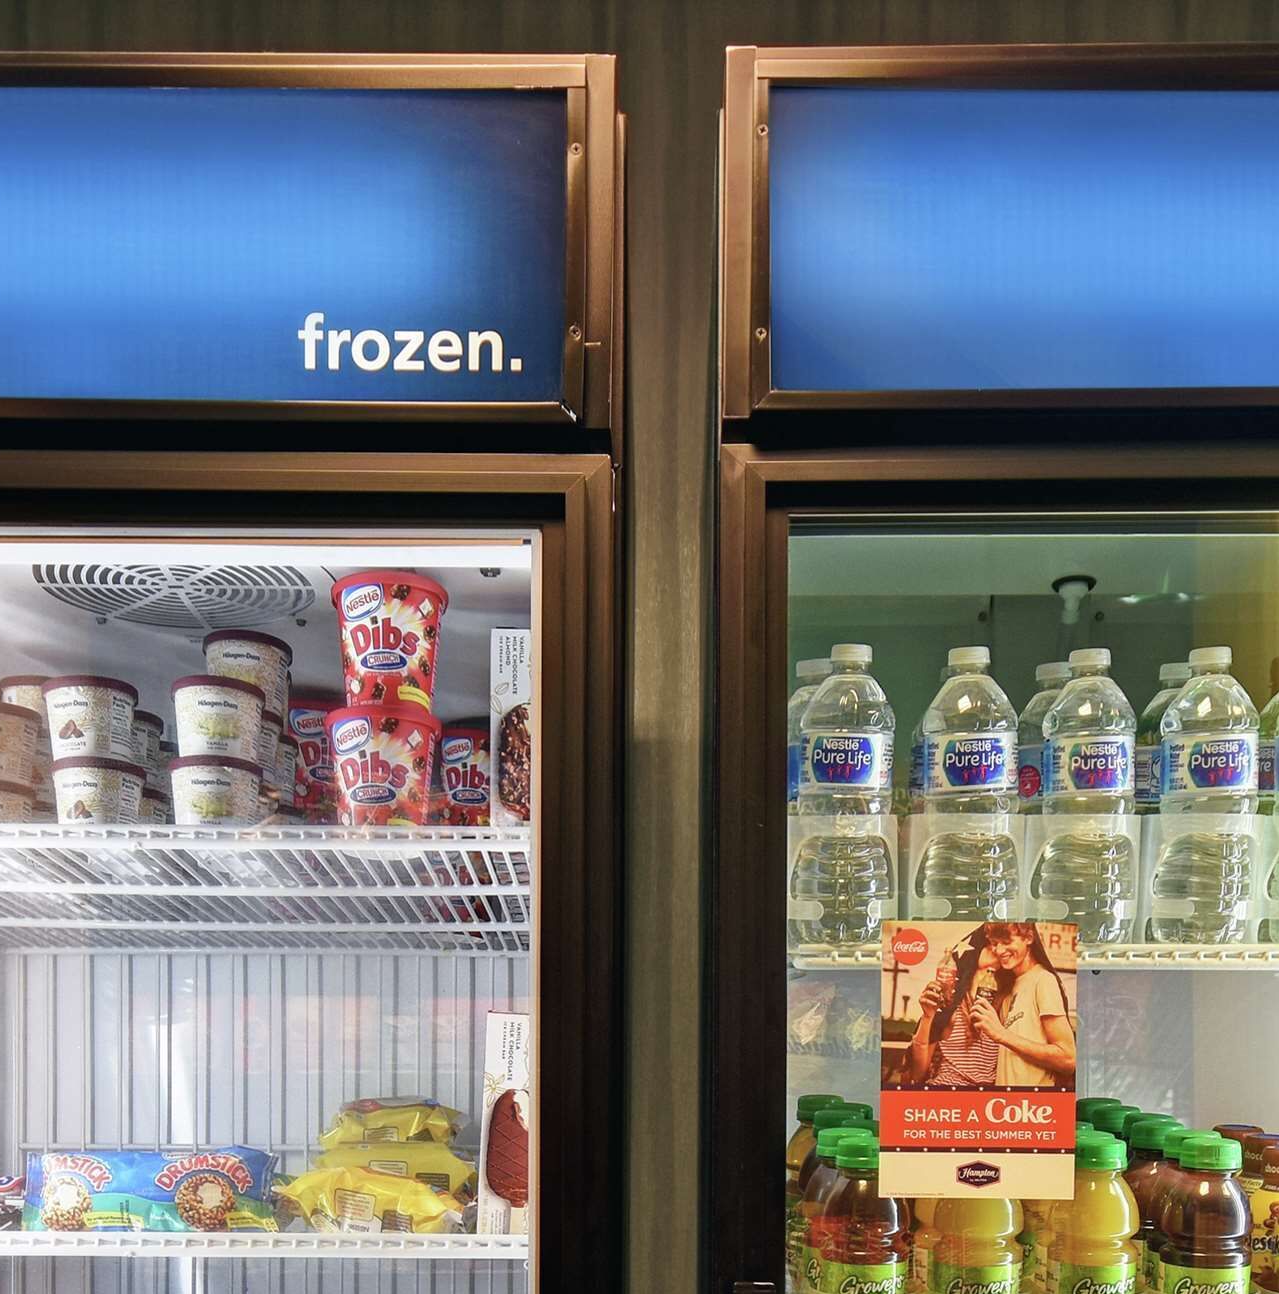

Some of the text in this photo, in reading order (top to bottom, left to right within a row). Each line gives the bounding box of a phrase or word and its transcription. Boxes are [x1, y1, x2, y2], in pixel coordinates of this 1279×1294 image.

[298, 312, 522, 372] frozen.
[350, 617, 420, 657] Dibs
[367, 653, 401, 666] CRUNCH
[813, 749, 871, 770] Pure Life
[946, 752, 1005, 771] Pure Life
[1071, 755, 1127, 774] Pure Life
[1191, 753, 1249, 773] Pure Life
[339, 750, 410, 792] Dibs
[355, 787, 390, 799] CRUNCH
[903, 1109, 980, 1123] SHARE A
[903, 1129, 1056, 1140] FOR THE BEST SUMMER YET
[156, 1152, 254, 1193] DRUMSTICK
[959, 1167, 998, 1181] Hampton
